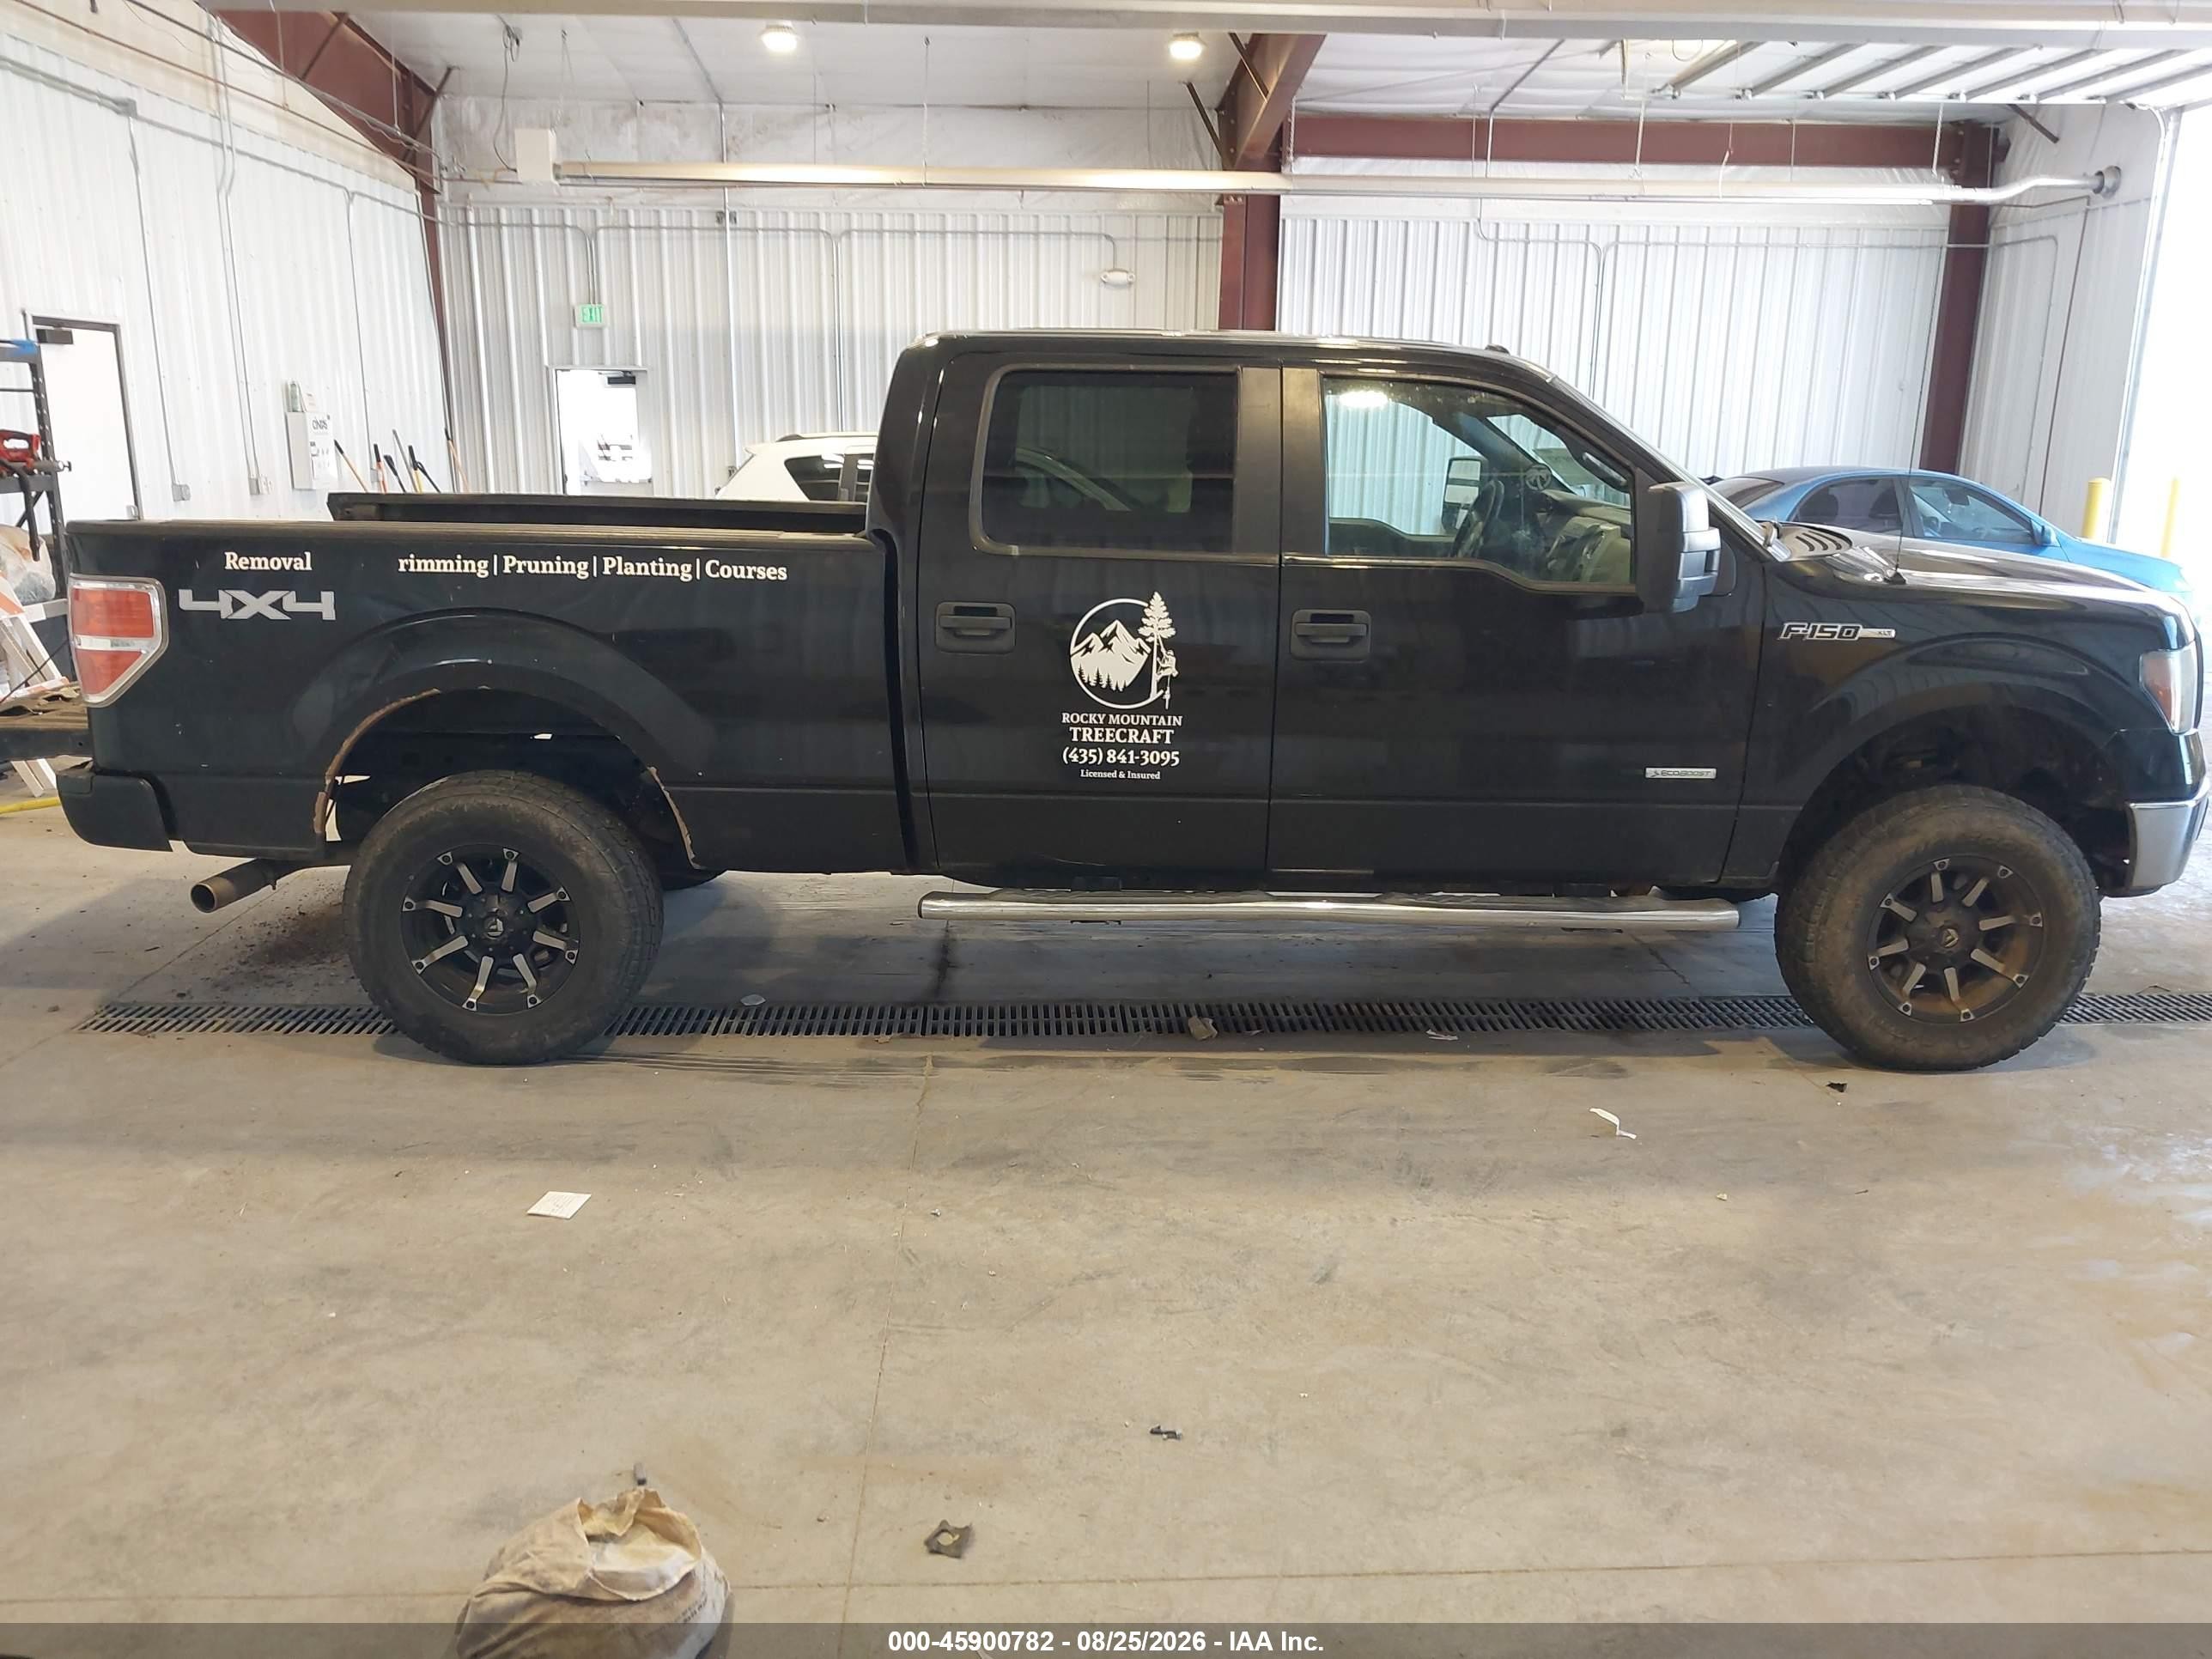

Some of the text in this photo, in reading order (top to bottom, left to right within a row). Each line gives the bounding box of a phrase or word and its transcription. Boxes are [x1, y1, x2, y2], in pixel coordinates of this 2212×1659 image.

[581, 306, 603, 323] EXIT
[224, 551, 313, 571] Removal
[398, 553, 491, 579] rimming
[502, 555, 590, 580] Pruning
[602, 556, 693, 582] Planting
[705, 559, 788, 580] Courses
[1778, 622, 1863, 641] F-150
[1061, 712, 1183, 726] ROCKY MOUNTAIN
[1069, 726, 1175, 744] TREECRAFT
[1062, 746, 1180, 767] (435) 841-3095
[1080, 769, 1161, 780] Licensed & Insured
